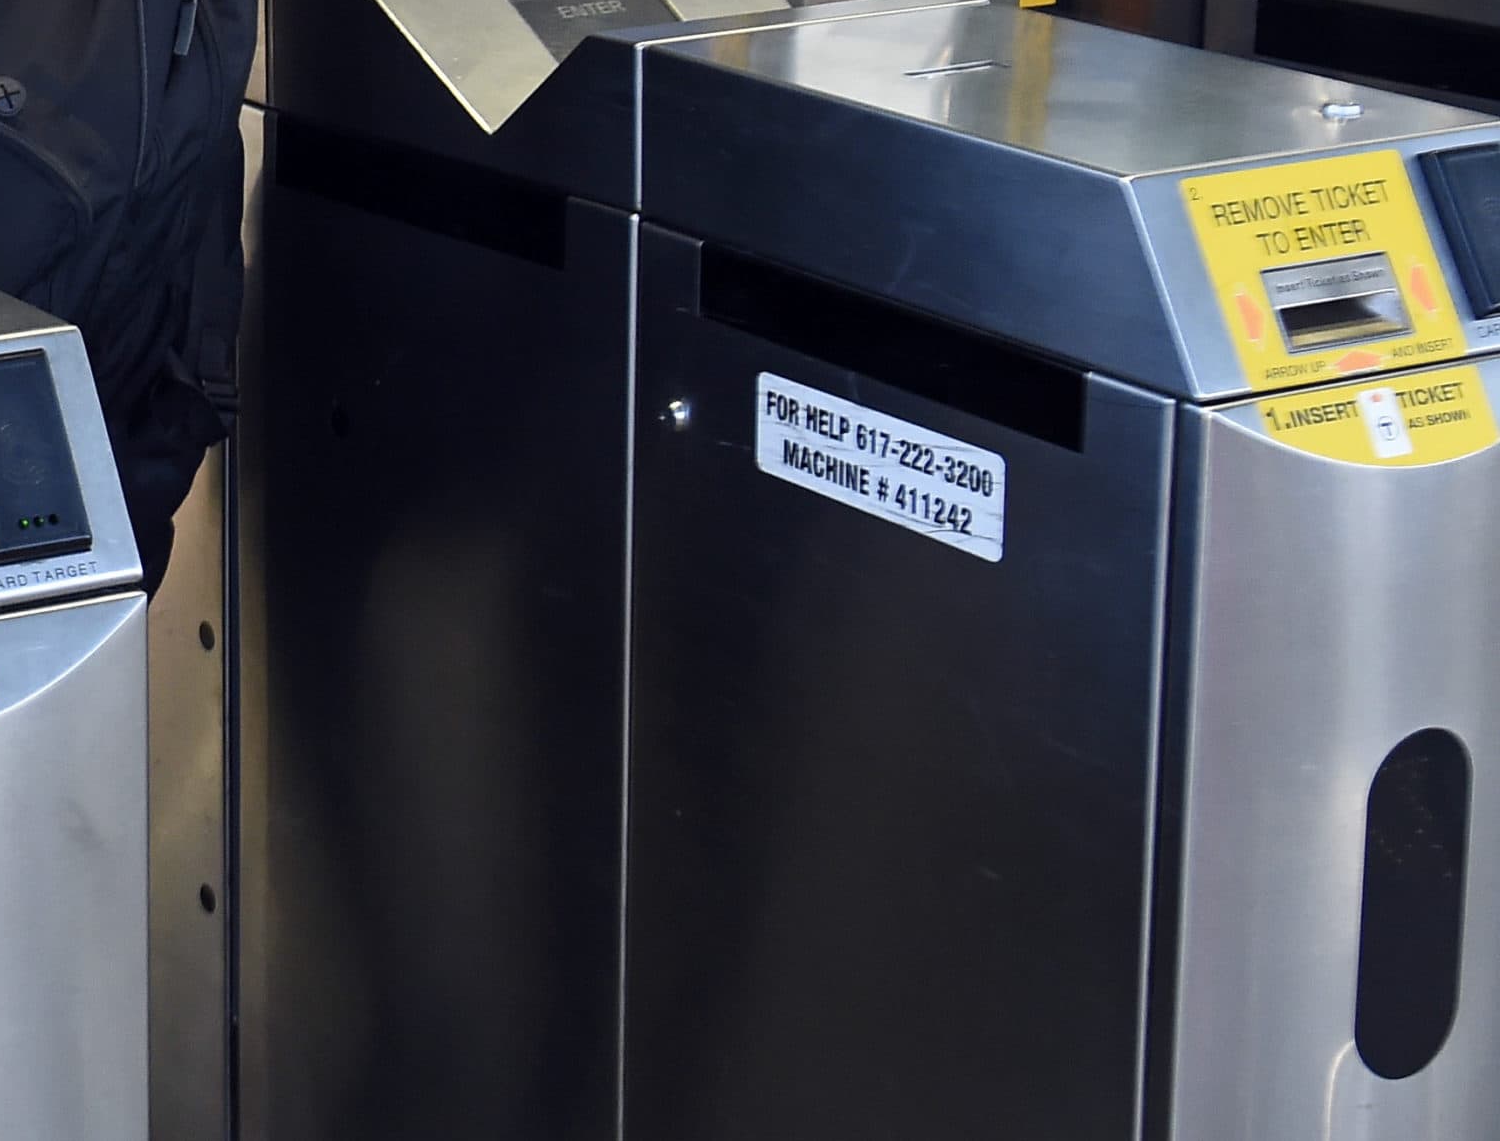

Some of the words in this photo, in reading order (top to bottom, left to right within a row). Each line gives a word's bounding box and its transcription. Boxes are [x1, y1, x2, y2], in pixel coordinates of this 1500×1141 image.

[557, 0, 626, 19] ENTER
[1212, 192, 1309, 227] REMOVE
[1311, 180, 1390, 211] TICKET
[1257, 231, 1291, 257] TO
[1297, 219, 1371, 251] ENTER
[1392, 346, 1414, 358] AND
[1417, 338, 1453, 354] INSERT
[1265, 363, 1306, 380] ARROW
[1309, 360, 1326, 374] UP
[1394, 382, 1466, 408] TICKET
[1408, 415, 1426, 429] AS
[1427, 409, 1471, 426] SHOWN
[766, 391, 800, 426] FOR
[805, 404, 850, 442] HELP
[856, 423, 994, 497] 617-222-3200
[784, 439, 871, 496] MACHINE
[877, 476, 890, 502] #
[895, 484, 973, 535] 411242
[34, 561, 98, 585] TARGET
